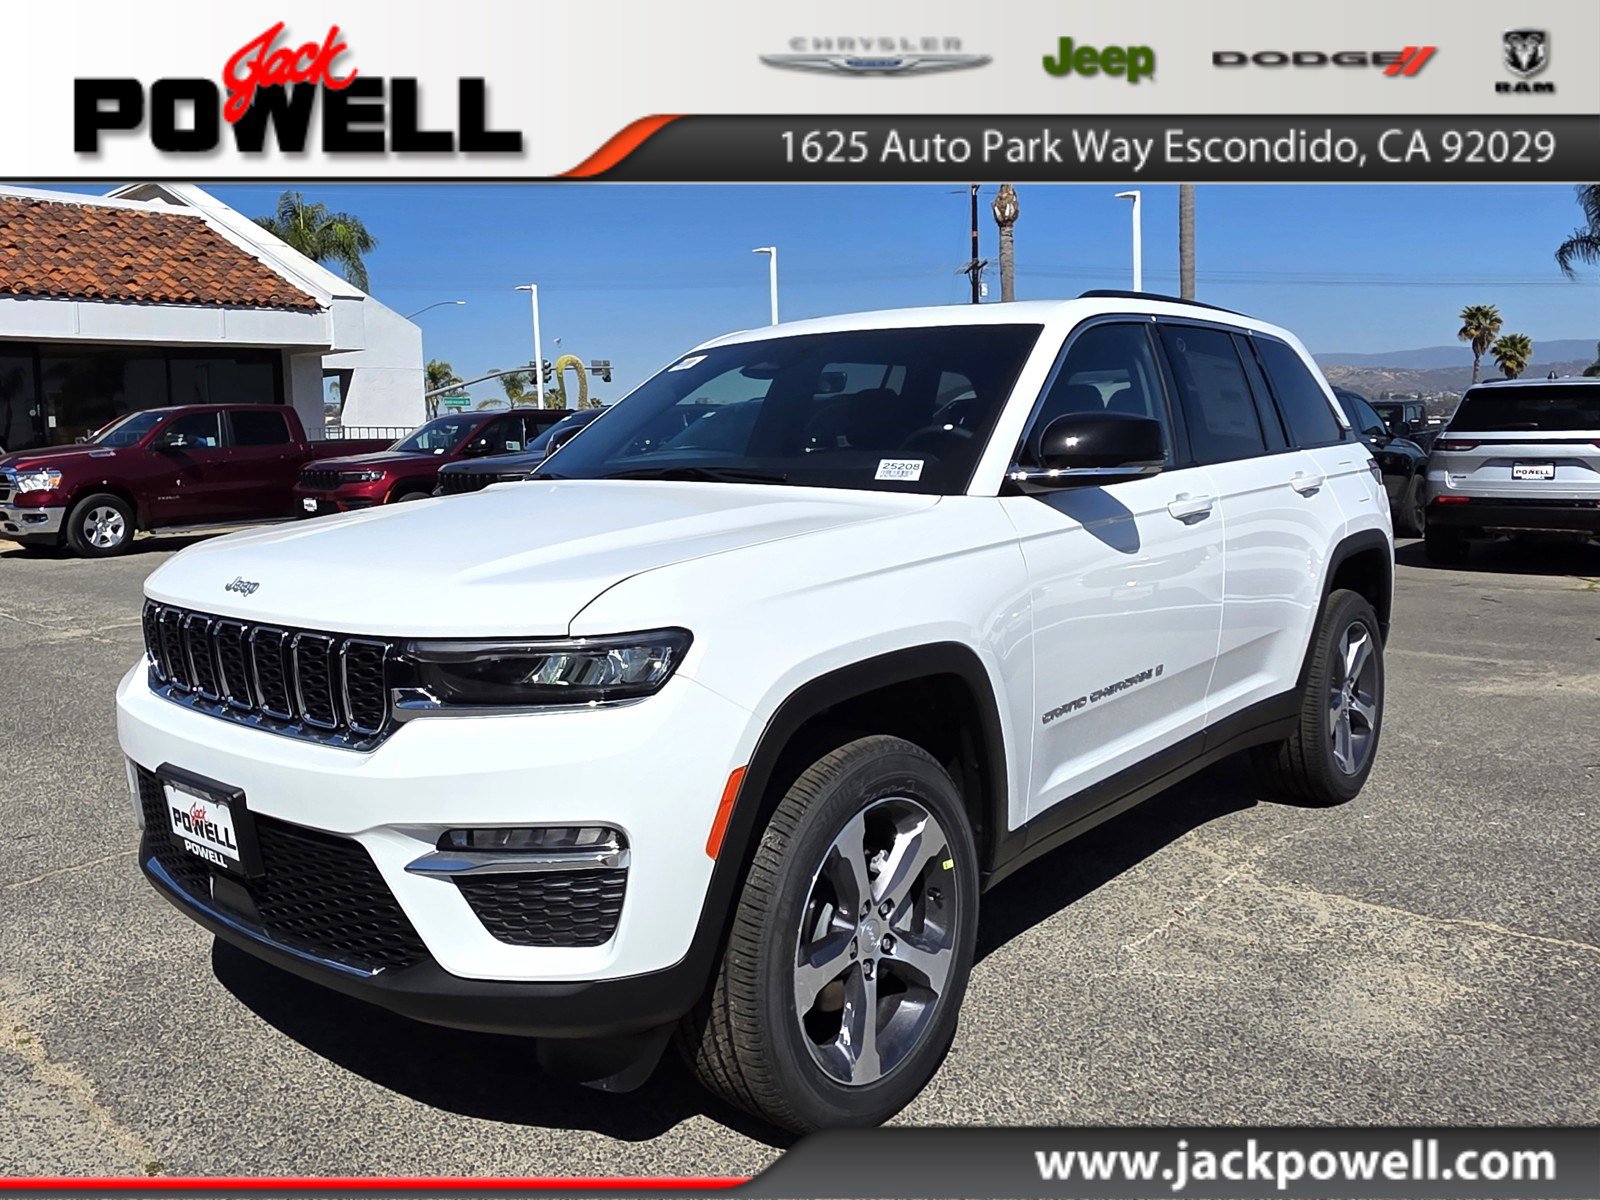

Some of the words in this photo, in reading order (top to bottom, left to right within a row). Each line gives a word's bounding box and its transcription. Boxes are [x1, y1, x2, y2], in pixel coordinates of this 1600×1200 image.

[882, 462, 921, 470] 25208
[225, 576, 260, 597] Jeep
[172, 807, 237, 851] POWELL
[184, 839, 228, 868] POWELL
